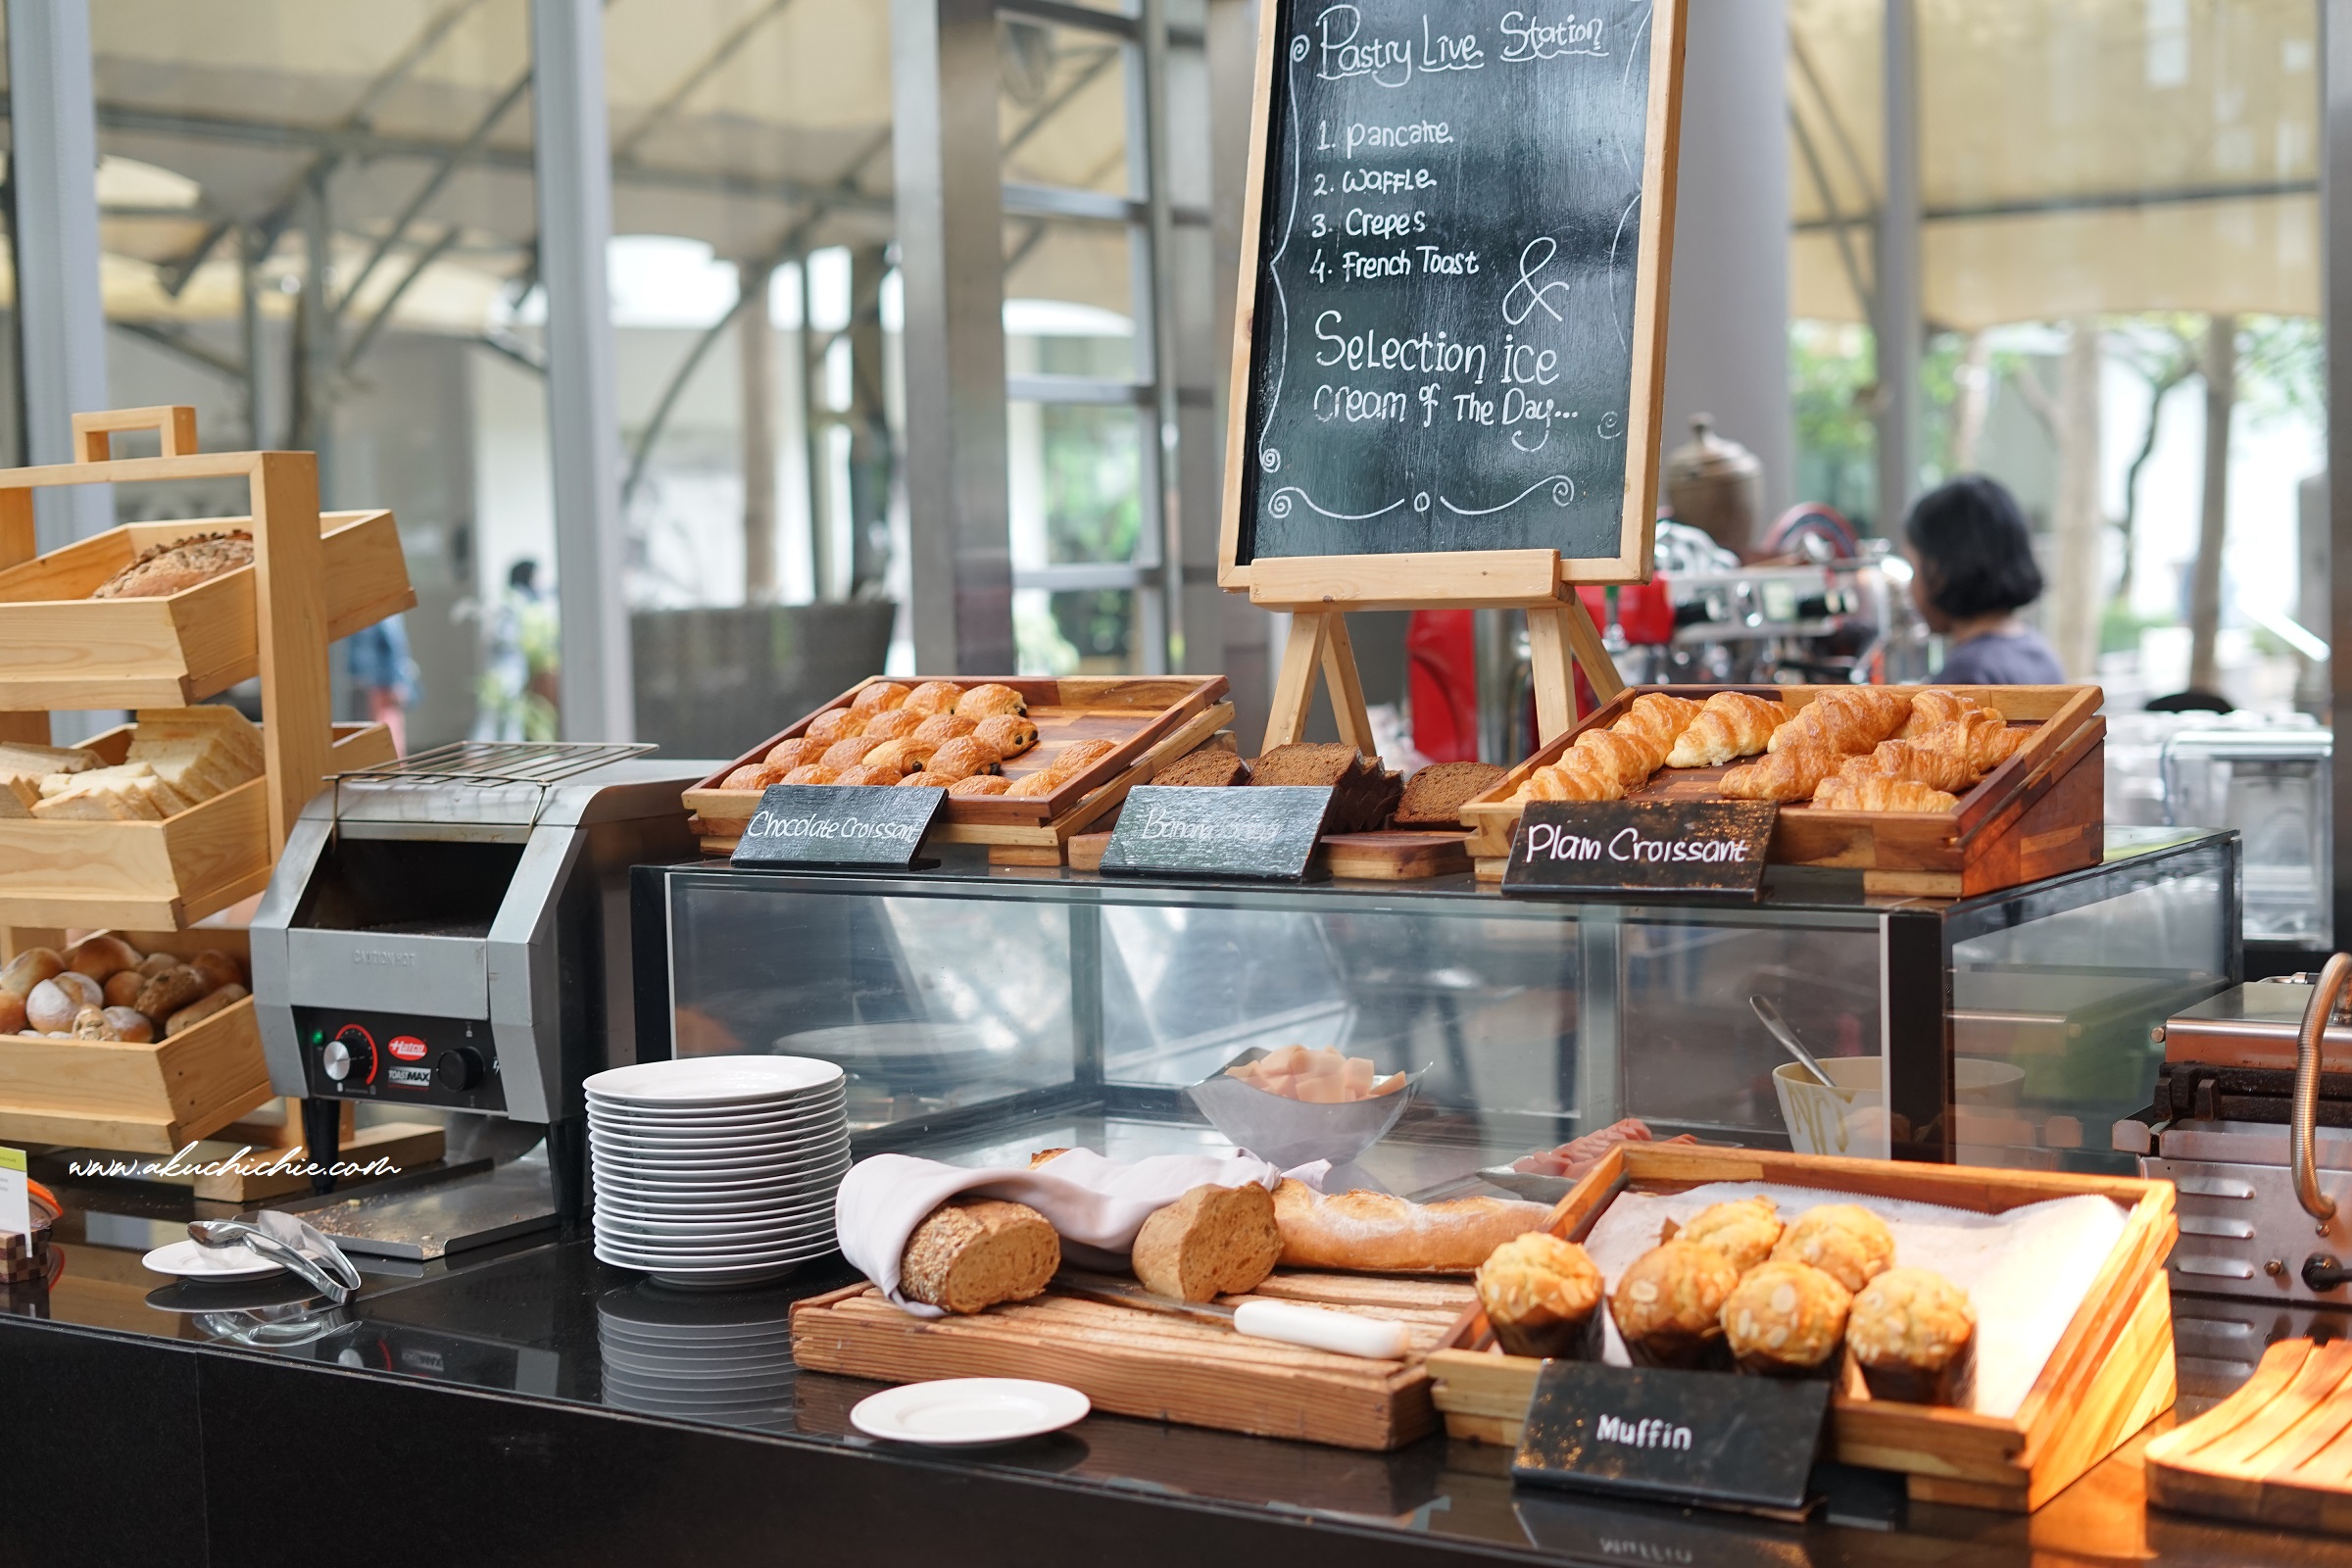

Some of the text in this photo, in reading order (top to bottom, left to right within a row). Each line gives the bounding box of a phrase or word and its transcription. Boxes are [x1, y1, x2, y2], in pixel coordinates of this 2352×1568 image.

[1316, 4, 1603, 87] Pastry Live Station
[1317, 121, 1337, 150] 1.
[1313, 173, 1335, 197] 2.
[1311, 208, 1427, 240] 3. Crepes
[1309, 245, 1480, 284] 4. French Toast
[1501, 236, 1570, 326] &
[1418, 382, 1442, 427] of
[1452, 391, 1494, 426] The
[747, 810, 922, 844] Chocolate Croissant
[1526, 823, 1749, 863] Plain Croissant
[389, 1040, 426, 1057] Hatco
[1595, 1413, 1693, 1451] Muffin
